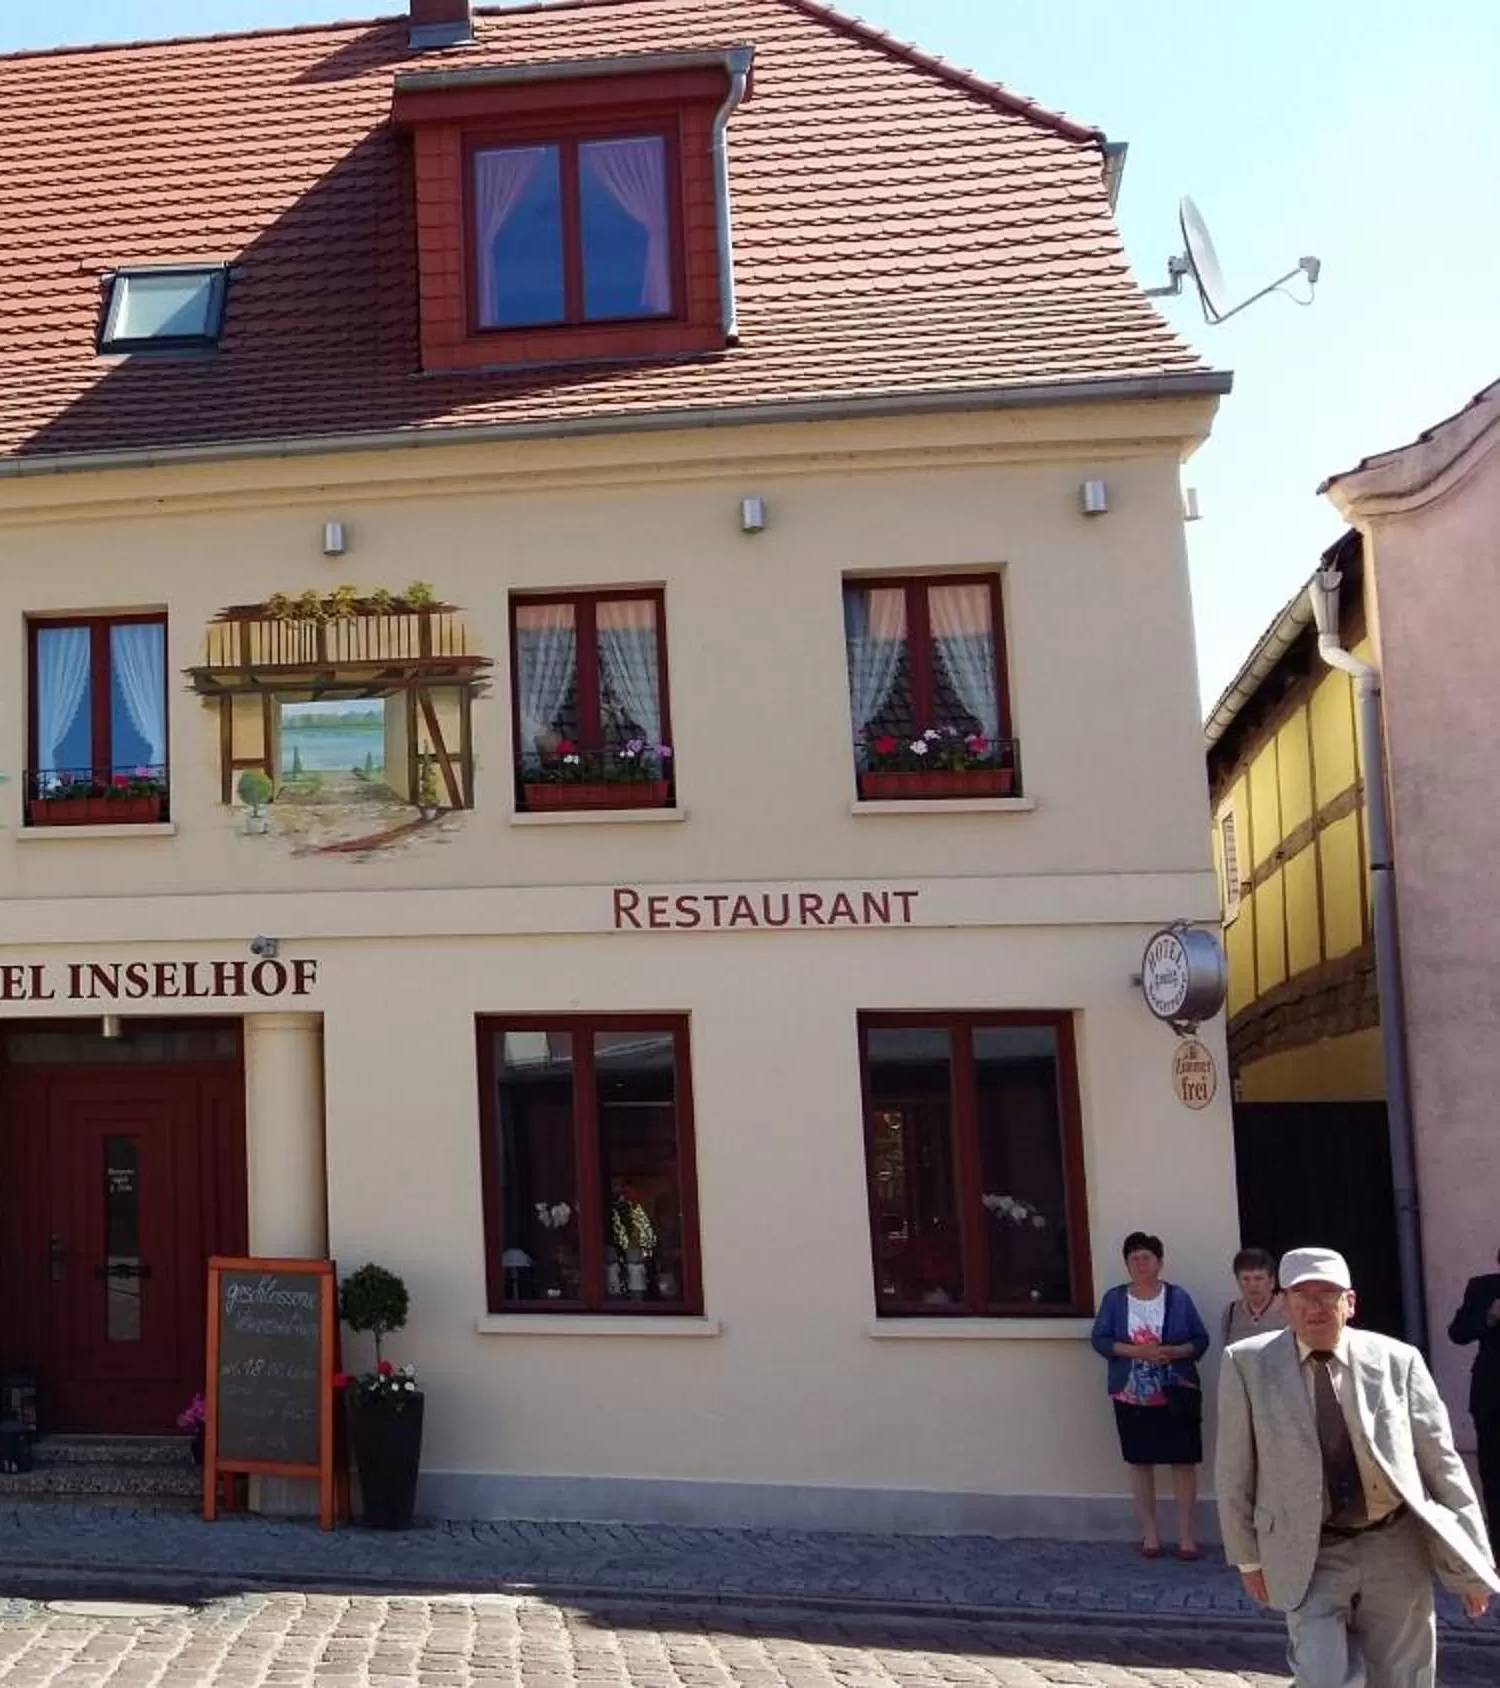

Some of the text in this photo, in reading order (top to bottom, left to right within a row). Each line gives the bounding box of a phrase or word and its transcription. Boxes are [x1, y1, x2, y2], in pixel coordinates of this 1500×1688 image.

[612, 887, 919, 928] RESTAURANT
[67, 959, 318, 999] INSELHOF
[1181, 1076, 1208, 1101] frei
